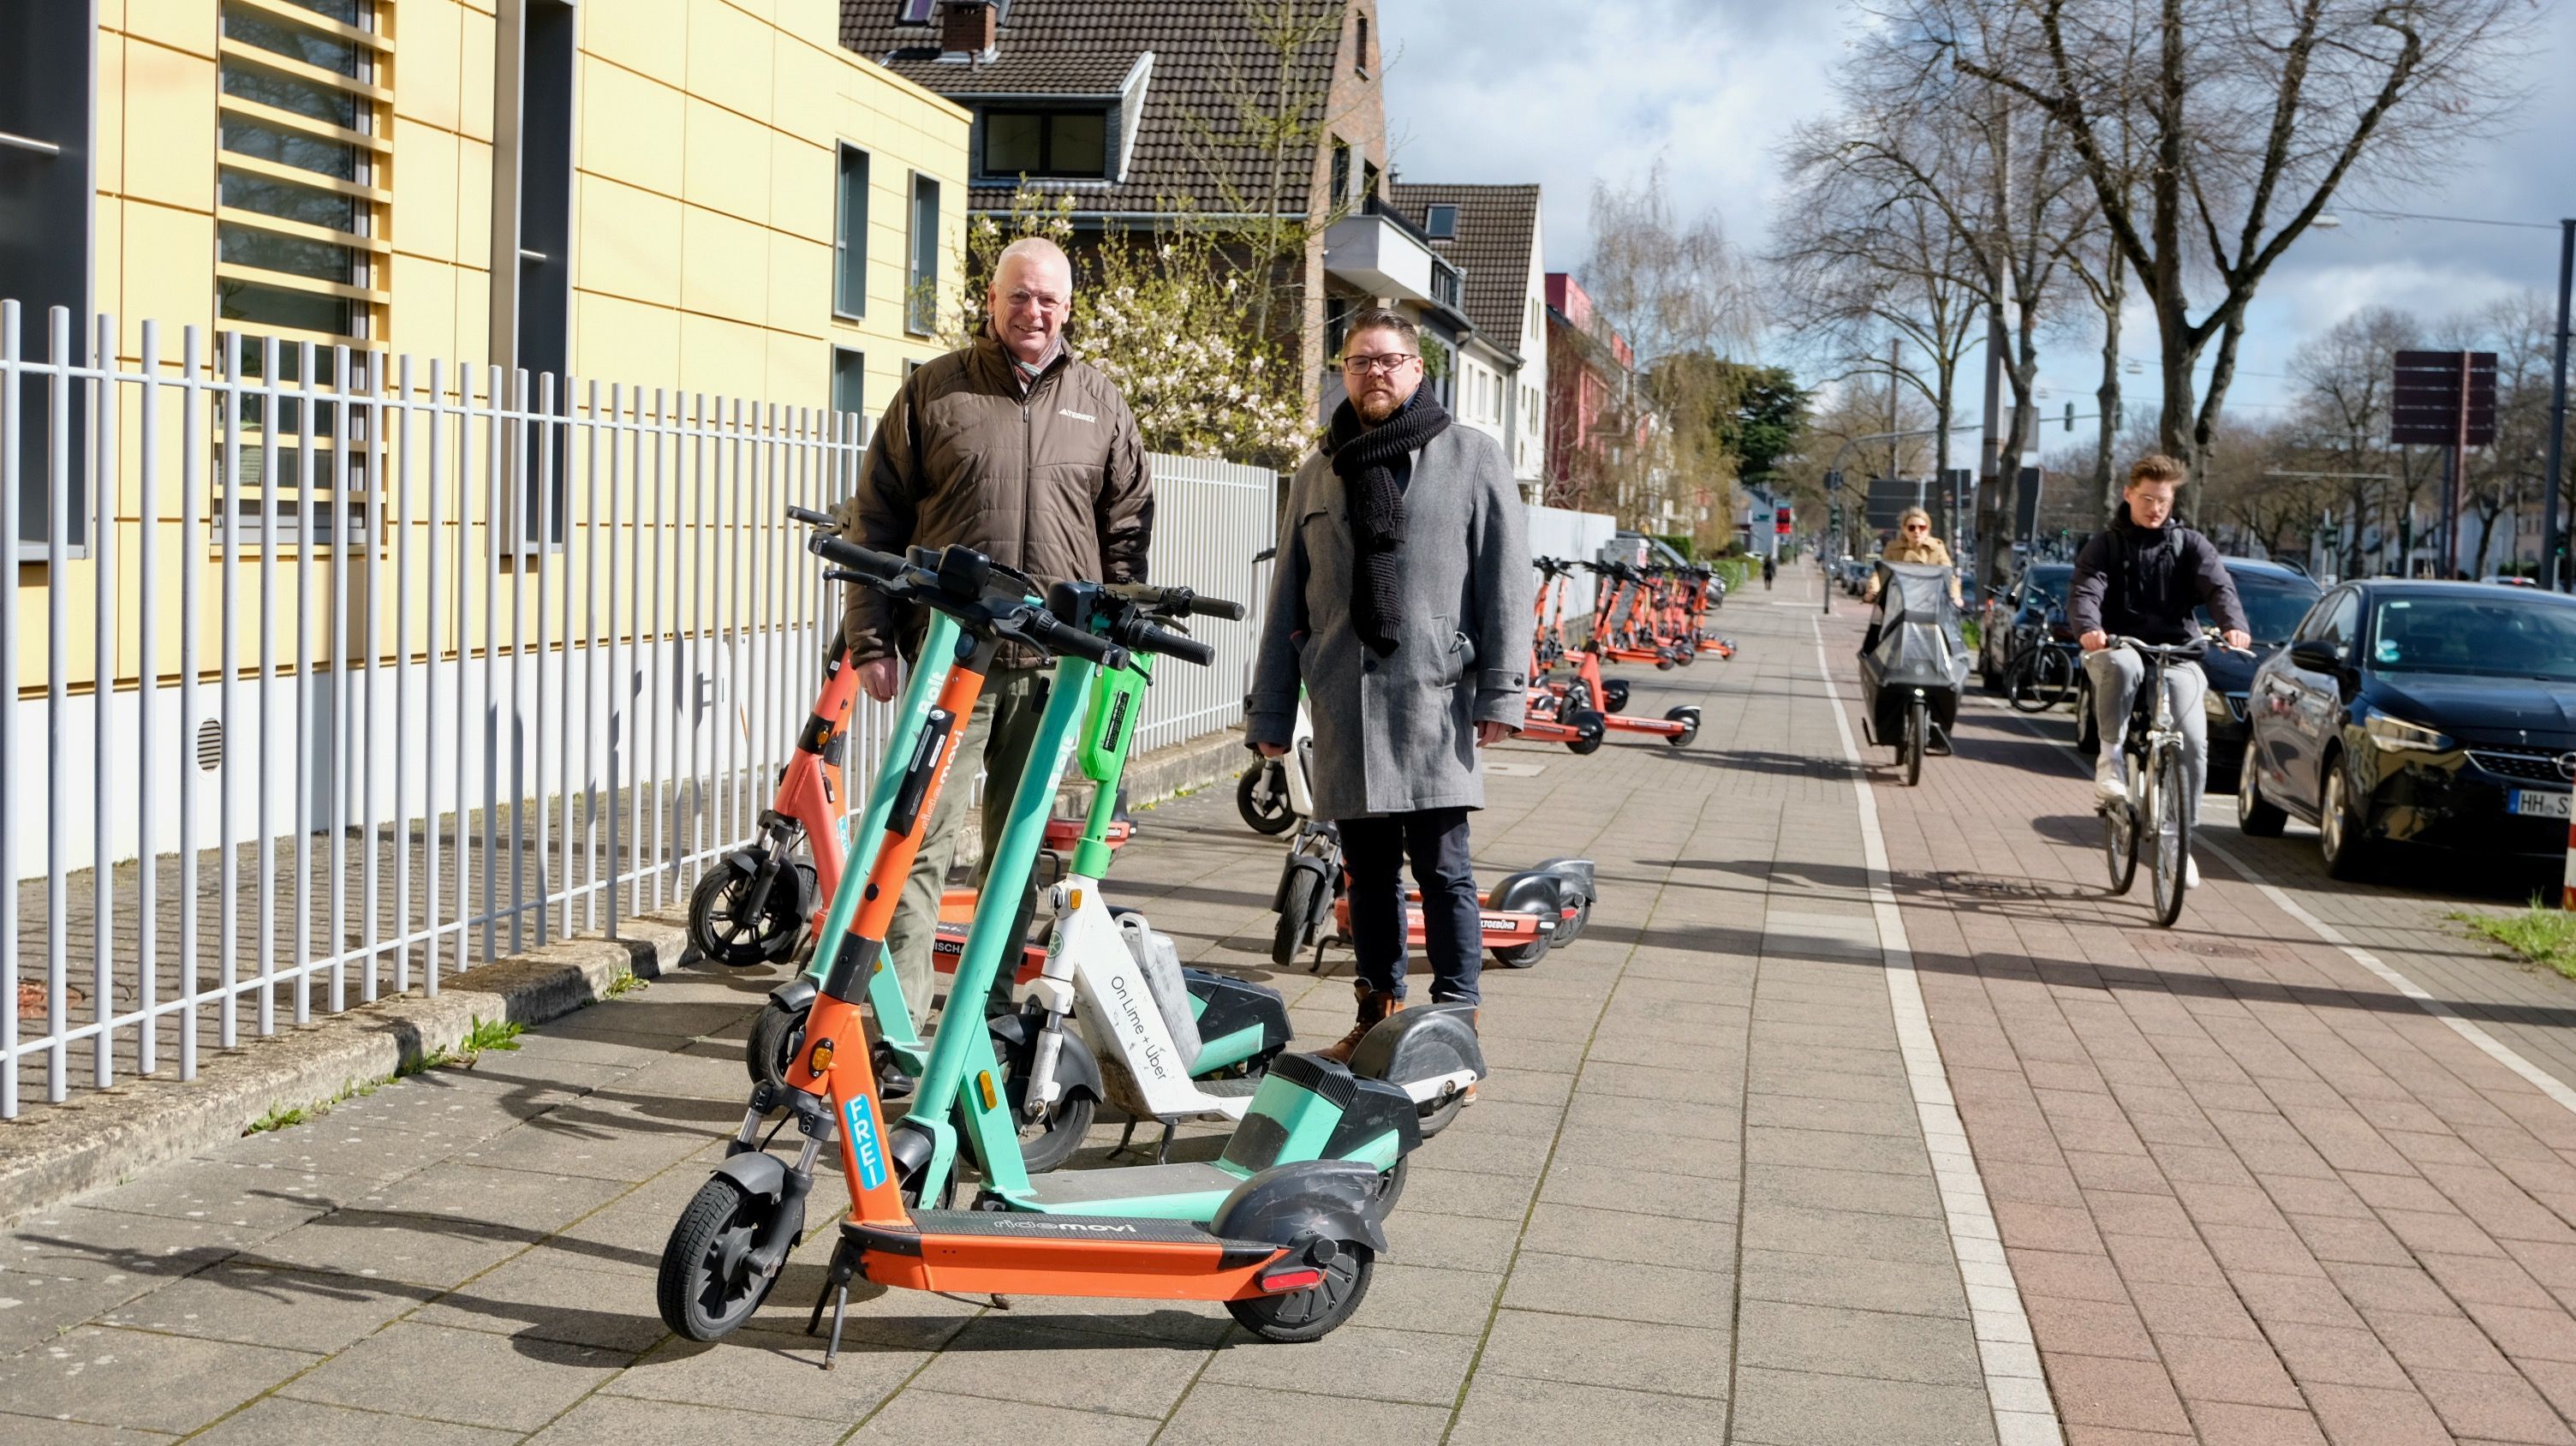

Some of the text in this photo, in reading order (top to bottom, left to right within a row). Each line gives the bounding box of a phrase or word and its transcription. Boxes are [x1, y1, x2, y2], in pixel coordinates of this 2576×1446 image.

[916, 671, 946, 714] Bolt
[921, 730, 964, 830] ridemovi
[1046, 735, 1074, 791] Bolt
[2520, 793, 2571, 815] HH S
[1480, 919, 1516, 929] LTGEBÜHR
[934, 942, 963, 953] ISCH
[1111, 976, 1127, 1001] On
[1122, 998, 1144, 1035] Lime
[1145, 1044, 1166, 1080] Uber
[850, 1096, 877, 1186] FREI
[993, 1219, 1137, 1233] ridemovi
